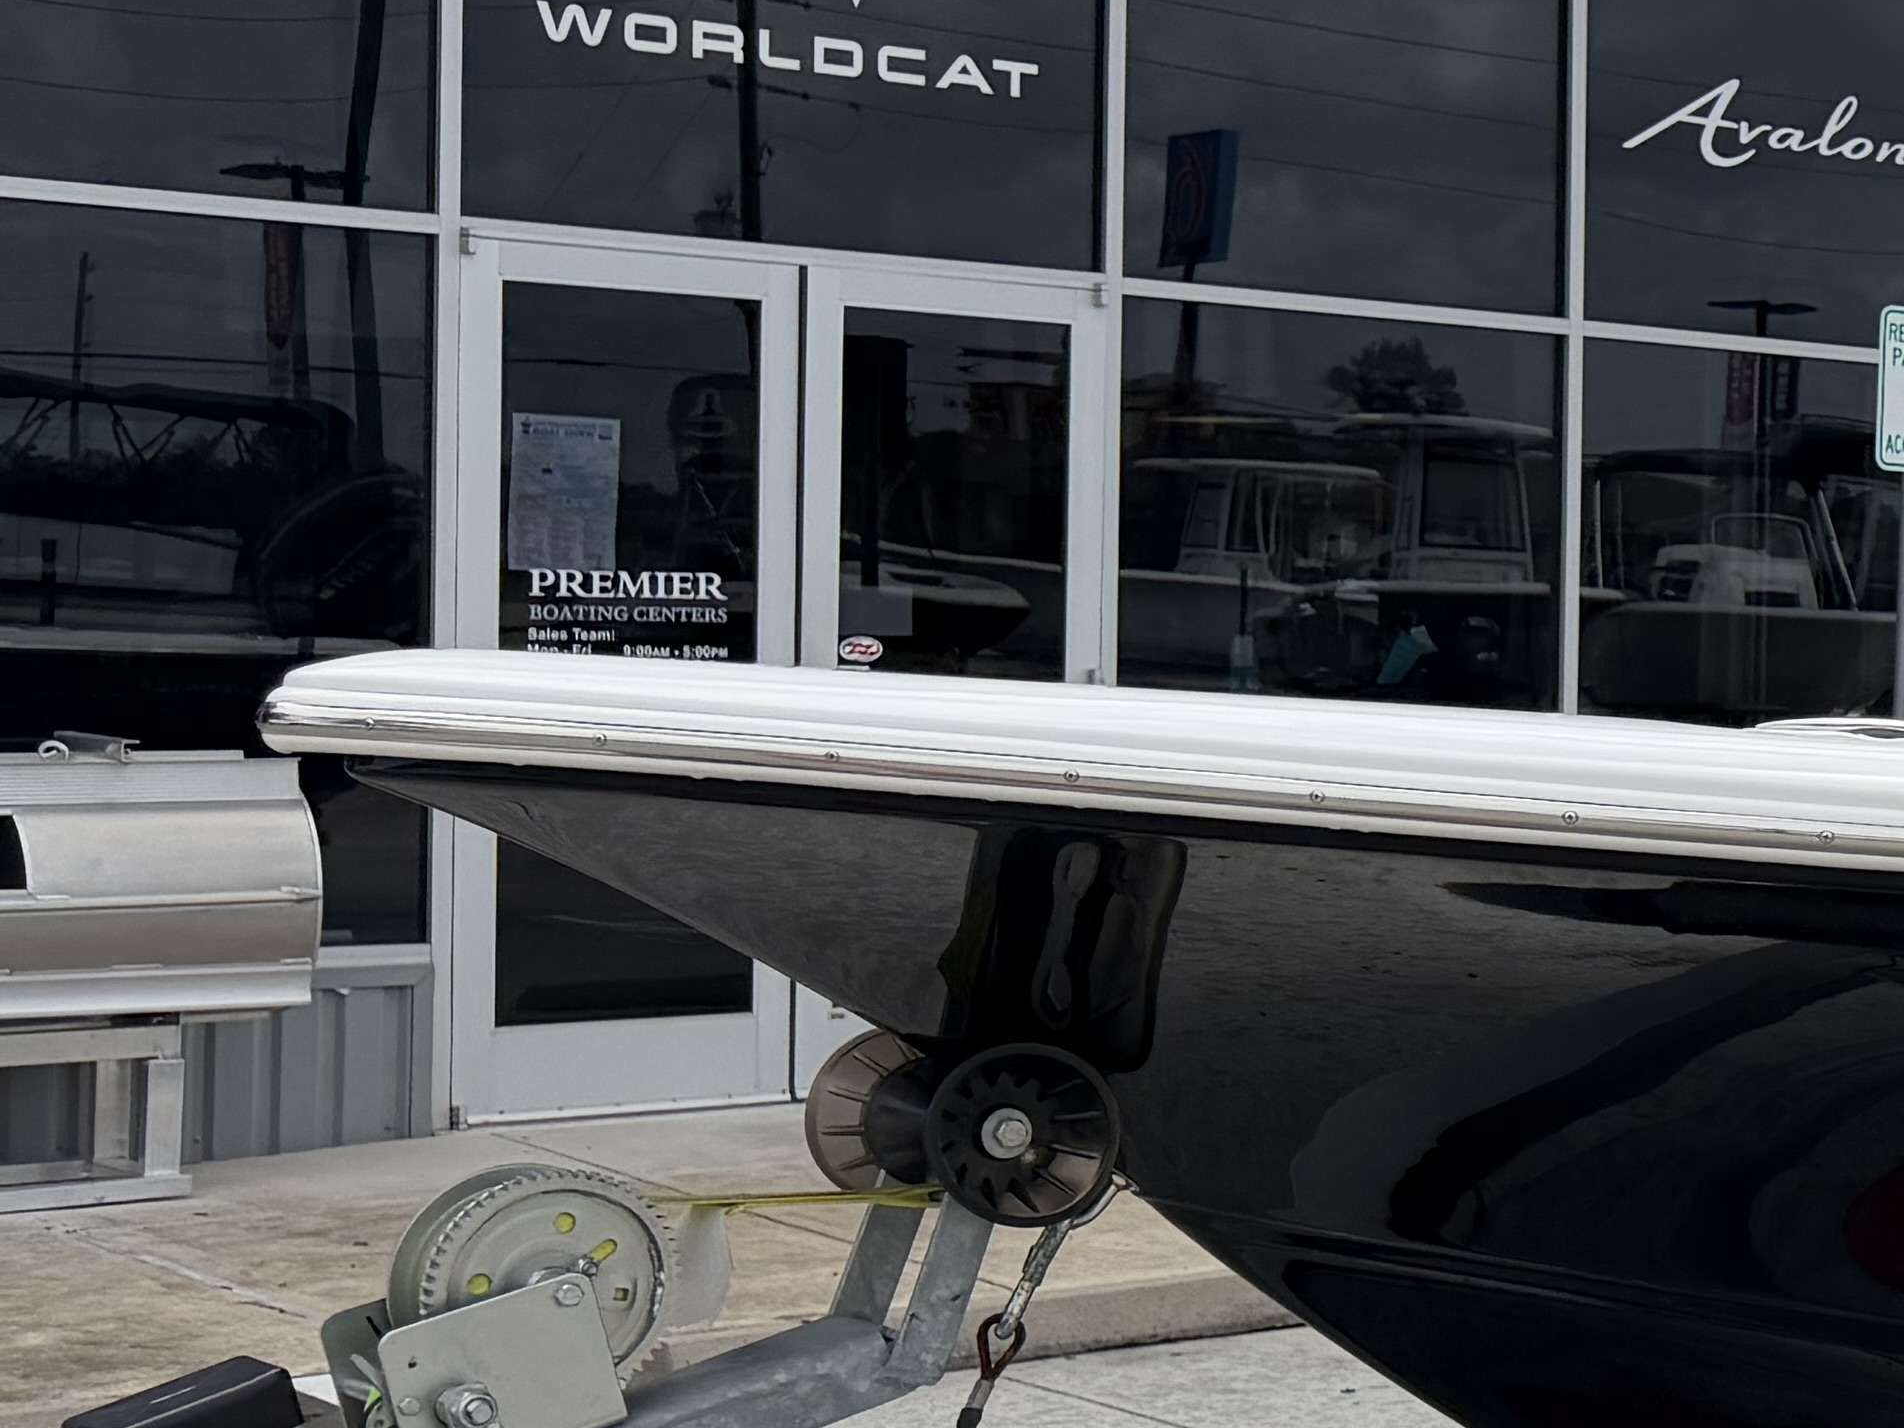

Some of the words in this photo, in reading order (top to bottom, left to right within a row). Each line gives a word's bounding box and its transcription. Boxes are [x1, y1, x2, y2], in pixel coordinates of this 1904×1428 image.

[536, 0, 1039, 98] WORLDCAT
[528, 568, 729, 601] PREMIER
[528, 603, 629, 623] BOATING
[633, 605, 729, 624] CENTERS
[527, 626, 569, 642] Sales
